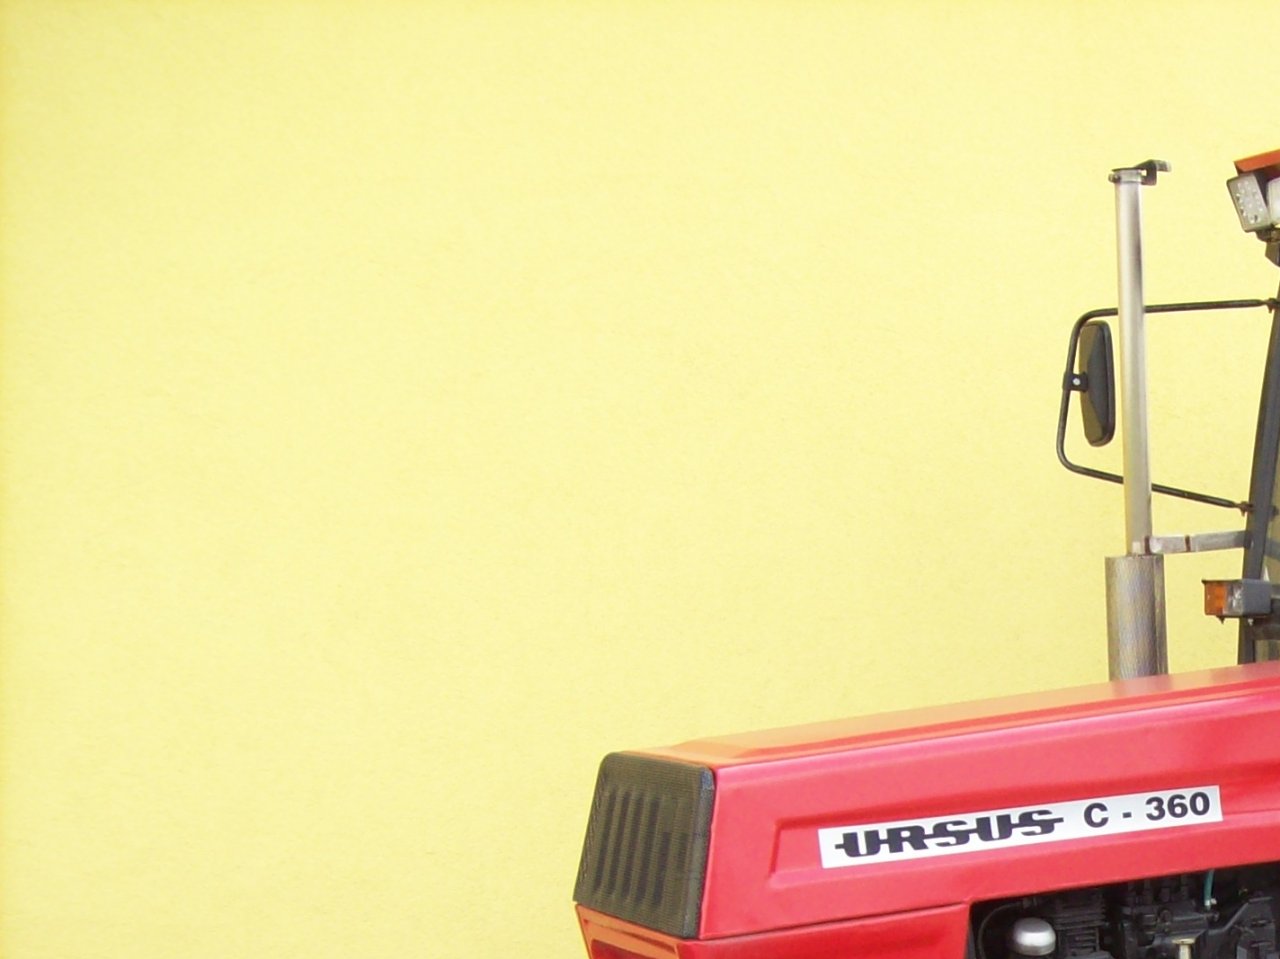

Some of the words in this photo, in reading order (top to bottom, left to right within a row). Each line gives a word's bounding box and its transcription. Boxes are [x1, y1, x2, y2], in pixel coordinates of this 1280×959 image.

[834, 809, 1064, 858] URSUS
[1083, 802, 1109, 828] C
[1145, 791, 1210, 821] 360
